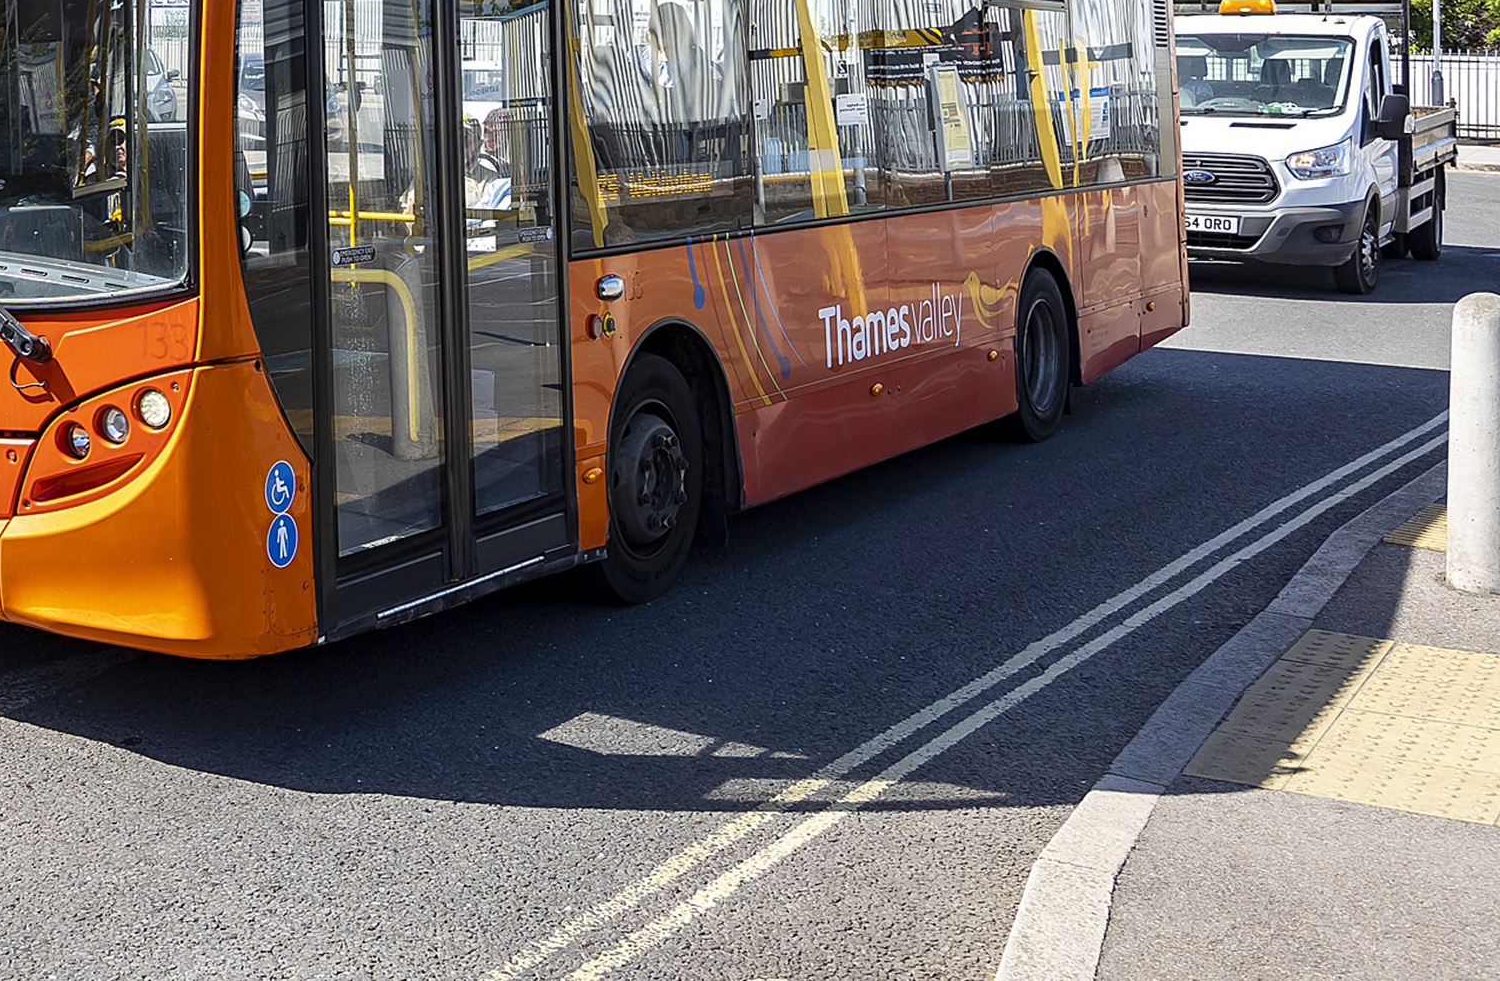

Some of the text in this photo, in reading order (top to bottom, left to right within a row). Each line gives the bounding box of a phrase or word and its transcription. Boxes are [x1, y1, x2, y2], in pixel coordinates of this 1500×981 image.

[1204, 218, 1231, 230] ORO
[818, 282, 963, 368] Thames valley
